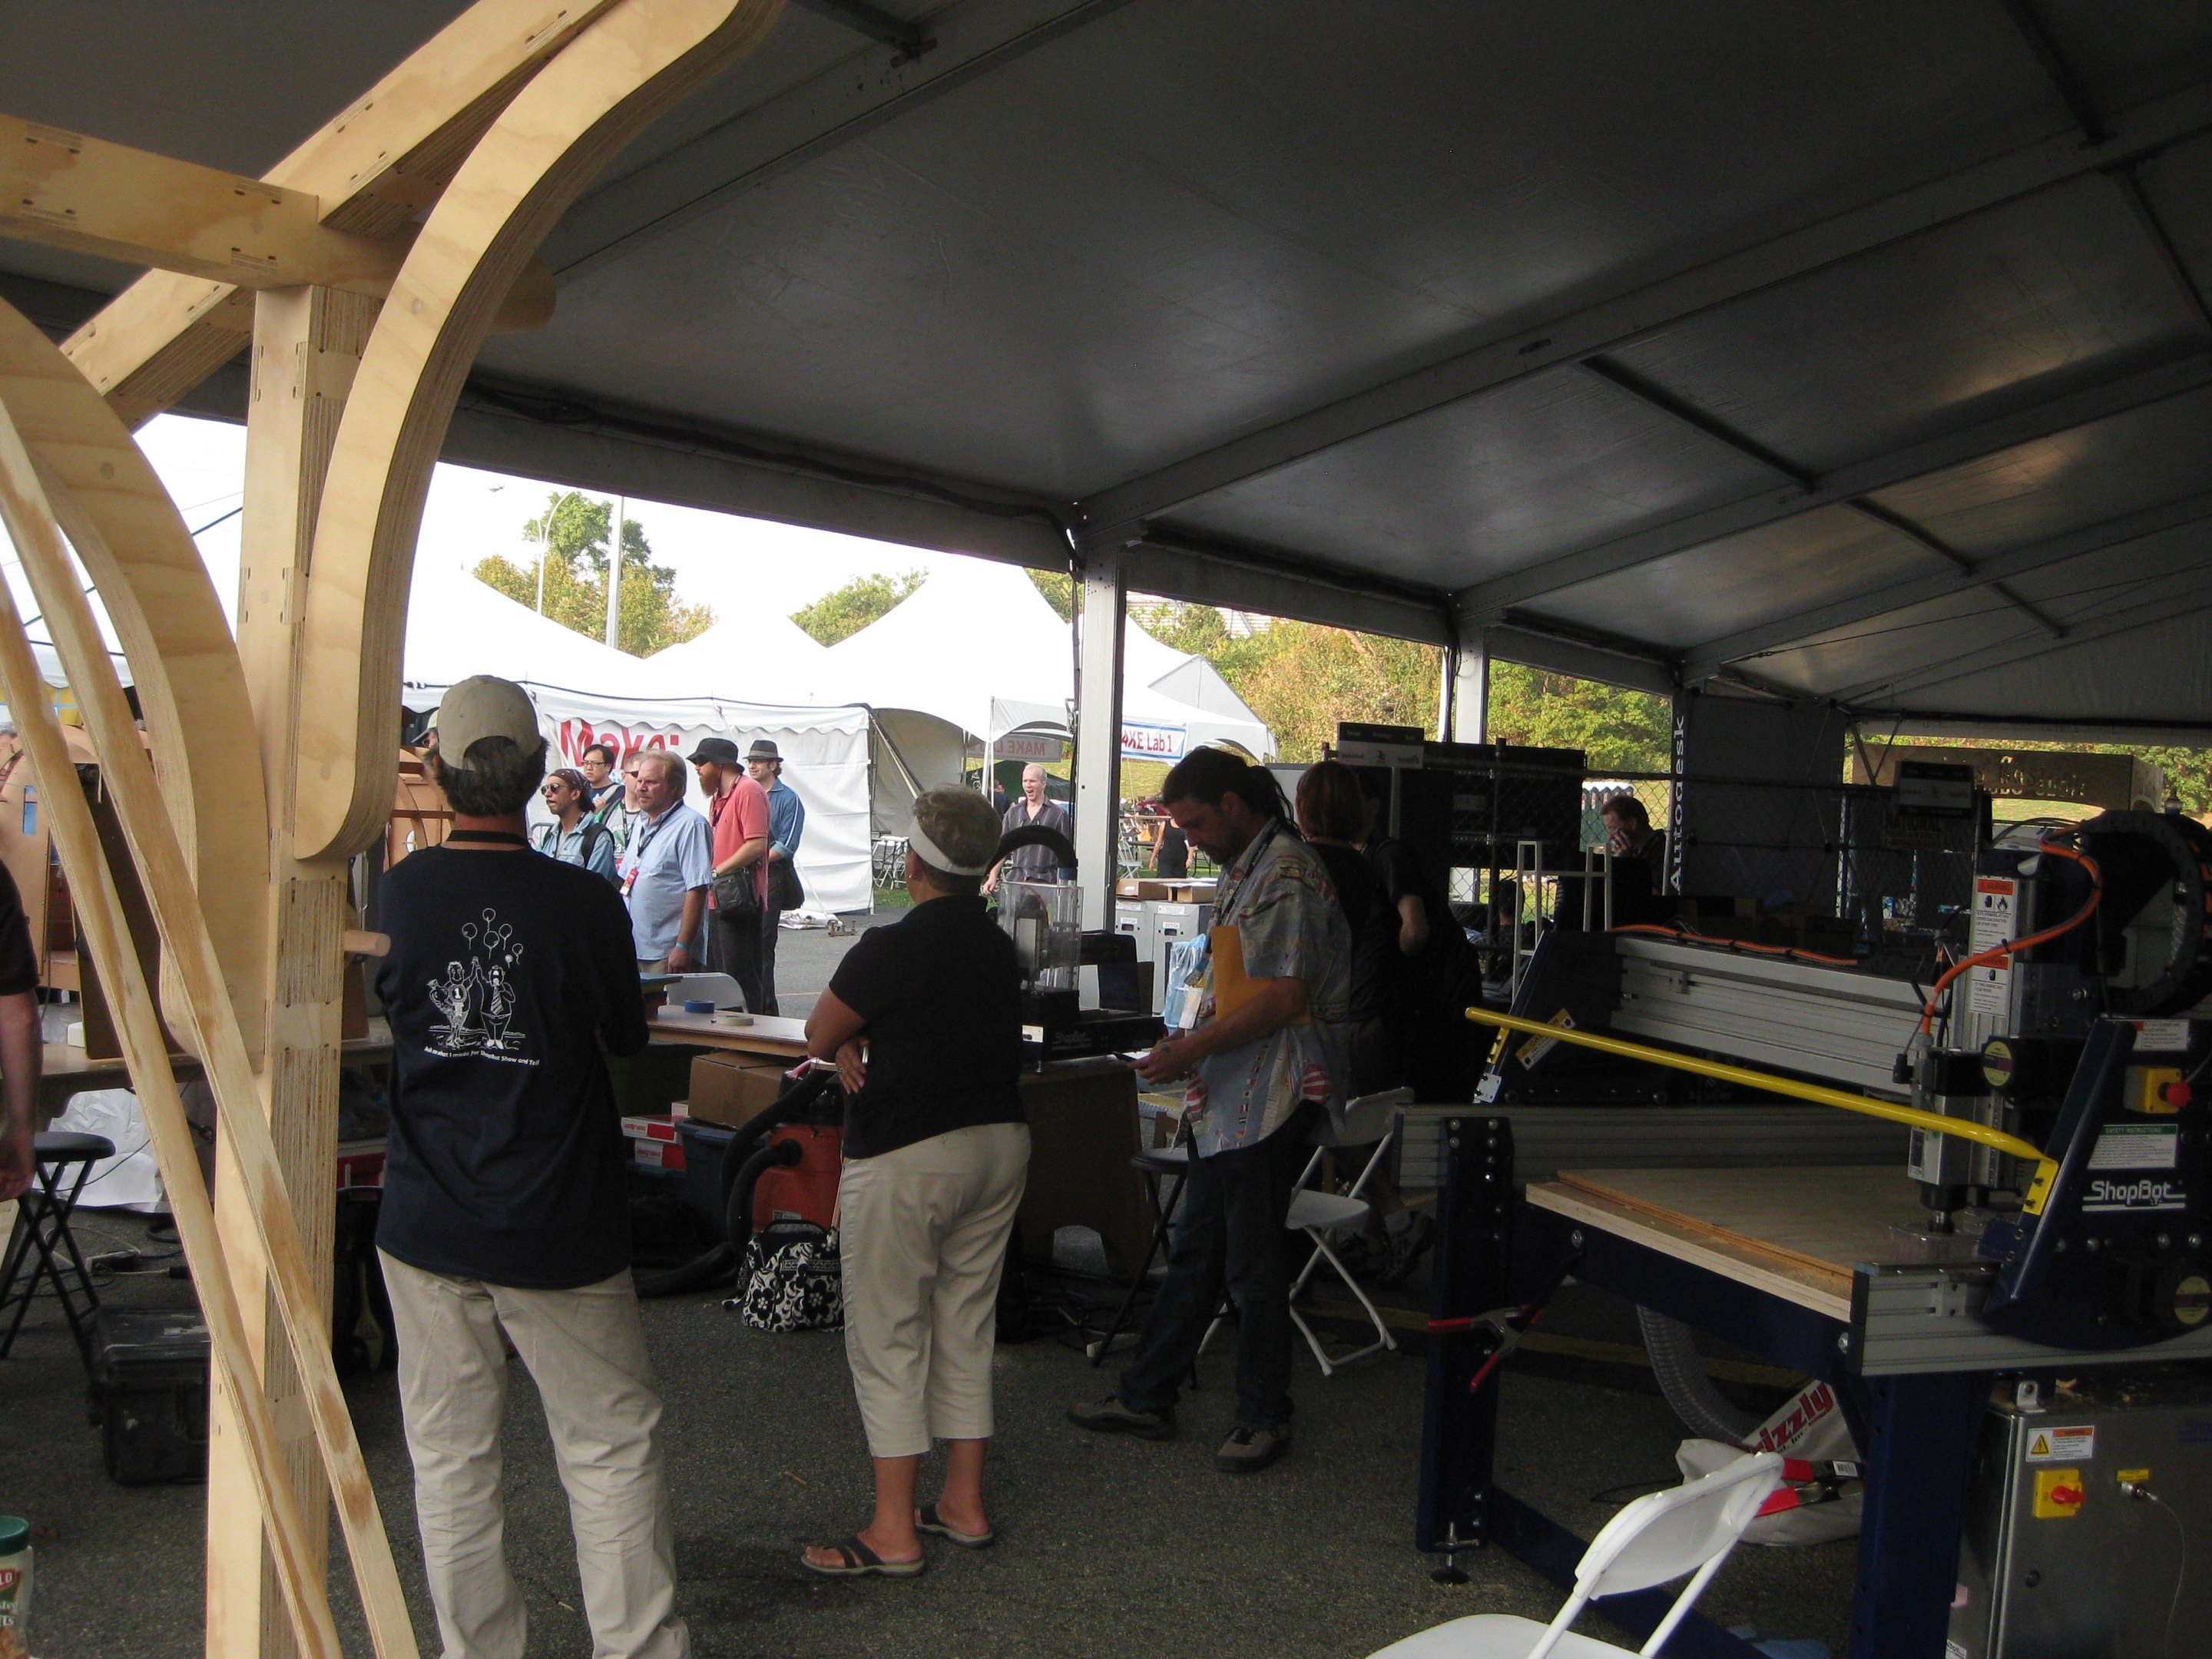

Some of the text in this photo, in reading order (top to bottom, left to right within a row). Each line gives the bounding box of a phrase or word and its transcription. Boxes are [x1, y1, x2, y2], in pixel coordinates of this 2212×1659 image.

[1121, 730, 1173, 753] AKE Lab 1
[2083, 1179, 2187, 1206] ShopBot
